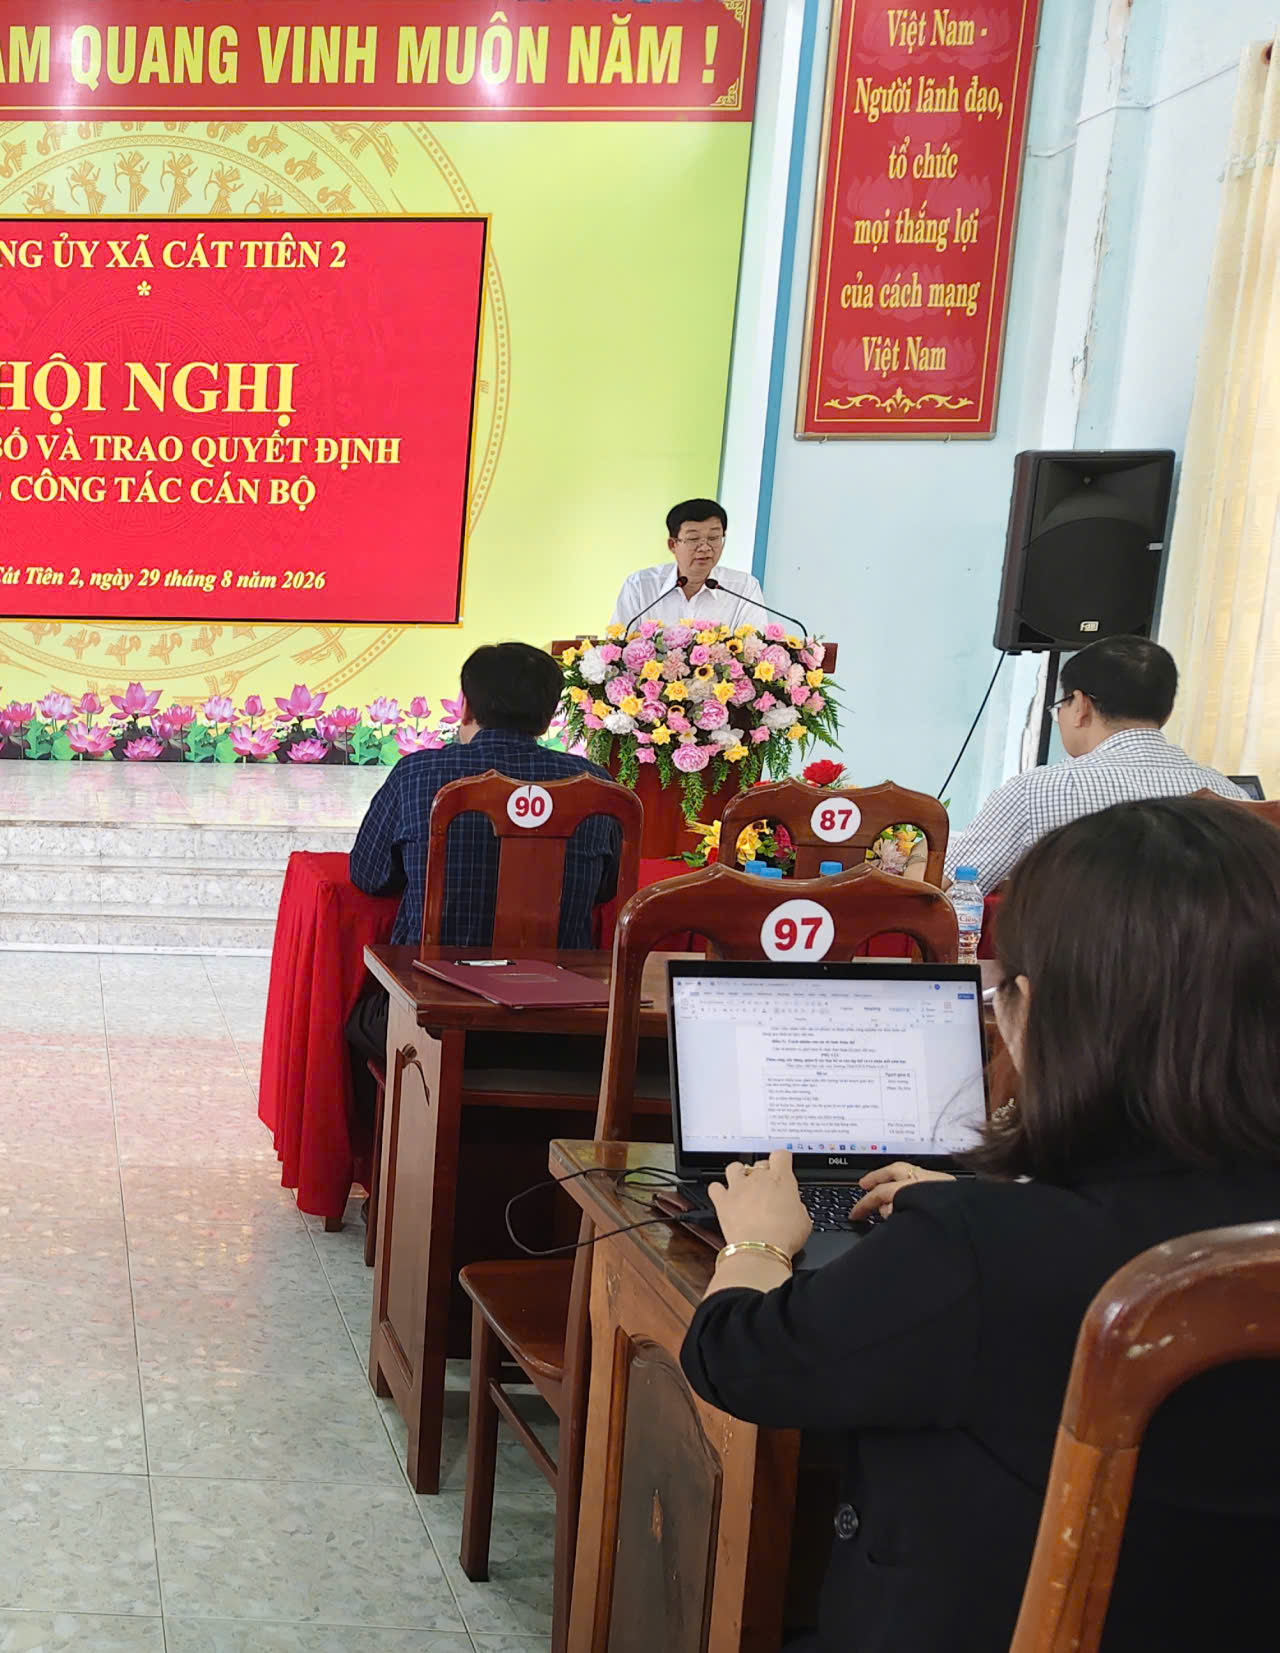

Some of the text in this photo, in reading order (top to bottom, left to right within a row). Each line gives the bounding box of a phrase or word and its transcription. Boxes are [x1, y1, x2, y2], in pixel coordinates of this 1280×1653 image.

[70, 25, 239, 92] QUANG
[258, 26, 377, 83] VINH
[396, 11, 548, 84] MUÔN
[568, 14, 683, 84] NĂM
[702, 26, 718, 84] !
[888, 9, 926, 53] Việt
[930, 9, 974, 46] Nam
[854, 76, 1002, 122] Người lãnh đạo,
[889, 136, 958, 179] tổ chức
[854, 200, 979, 252] mọi thắng lợi
[53, 232, 99, 267] ỦY
[106, 234, 153, 267] XÃ
[163, 233, 233, 268] CÁT
[240, 232, 322, 267] TIÊN
[330, 241, 346, 267] 2
[841, 272, 980, 316] của cách mạng
[863, 336, 946, 377] Việt Nam
[124, 362, 298, 427] NGHỊ
[39, 428, 81, 461] VÀ
[90, 436, 183, 461] TRAO
[192, 430, 308, 467] QUYẾT
[315, 438, 401, 470] ĐỊNH
[11, 468, 106, 502] CÔNG
[114, 470, 181, 503] TÁC
[191, 471, 260, 504] CÁN
[268, 475, 315, 511] BỘ
[26, 567, 64, 585] Tiên
[69, 566, 85, 589] 2,
[90, 568, 133, 590] ngày
[138, 569, 160, 586] 29
[164, 569, 217, 592] tháng
[221, 570, 232, 587] 8
[237, 571, 276, 588] năm
[282, 571, 325, 589] 2026
[516, 797, 545, 817] 90
[820, 810, 852, 830] 87
[775, 917, 822, 951] 97
[829, 1157, 848, 1165] DELL
